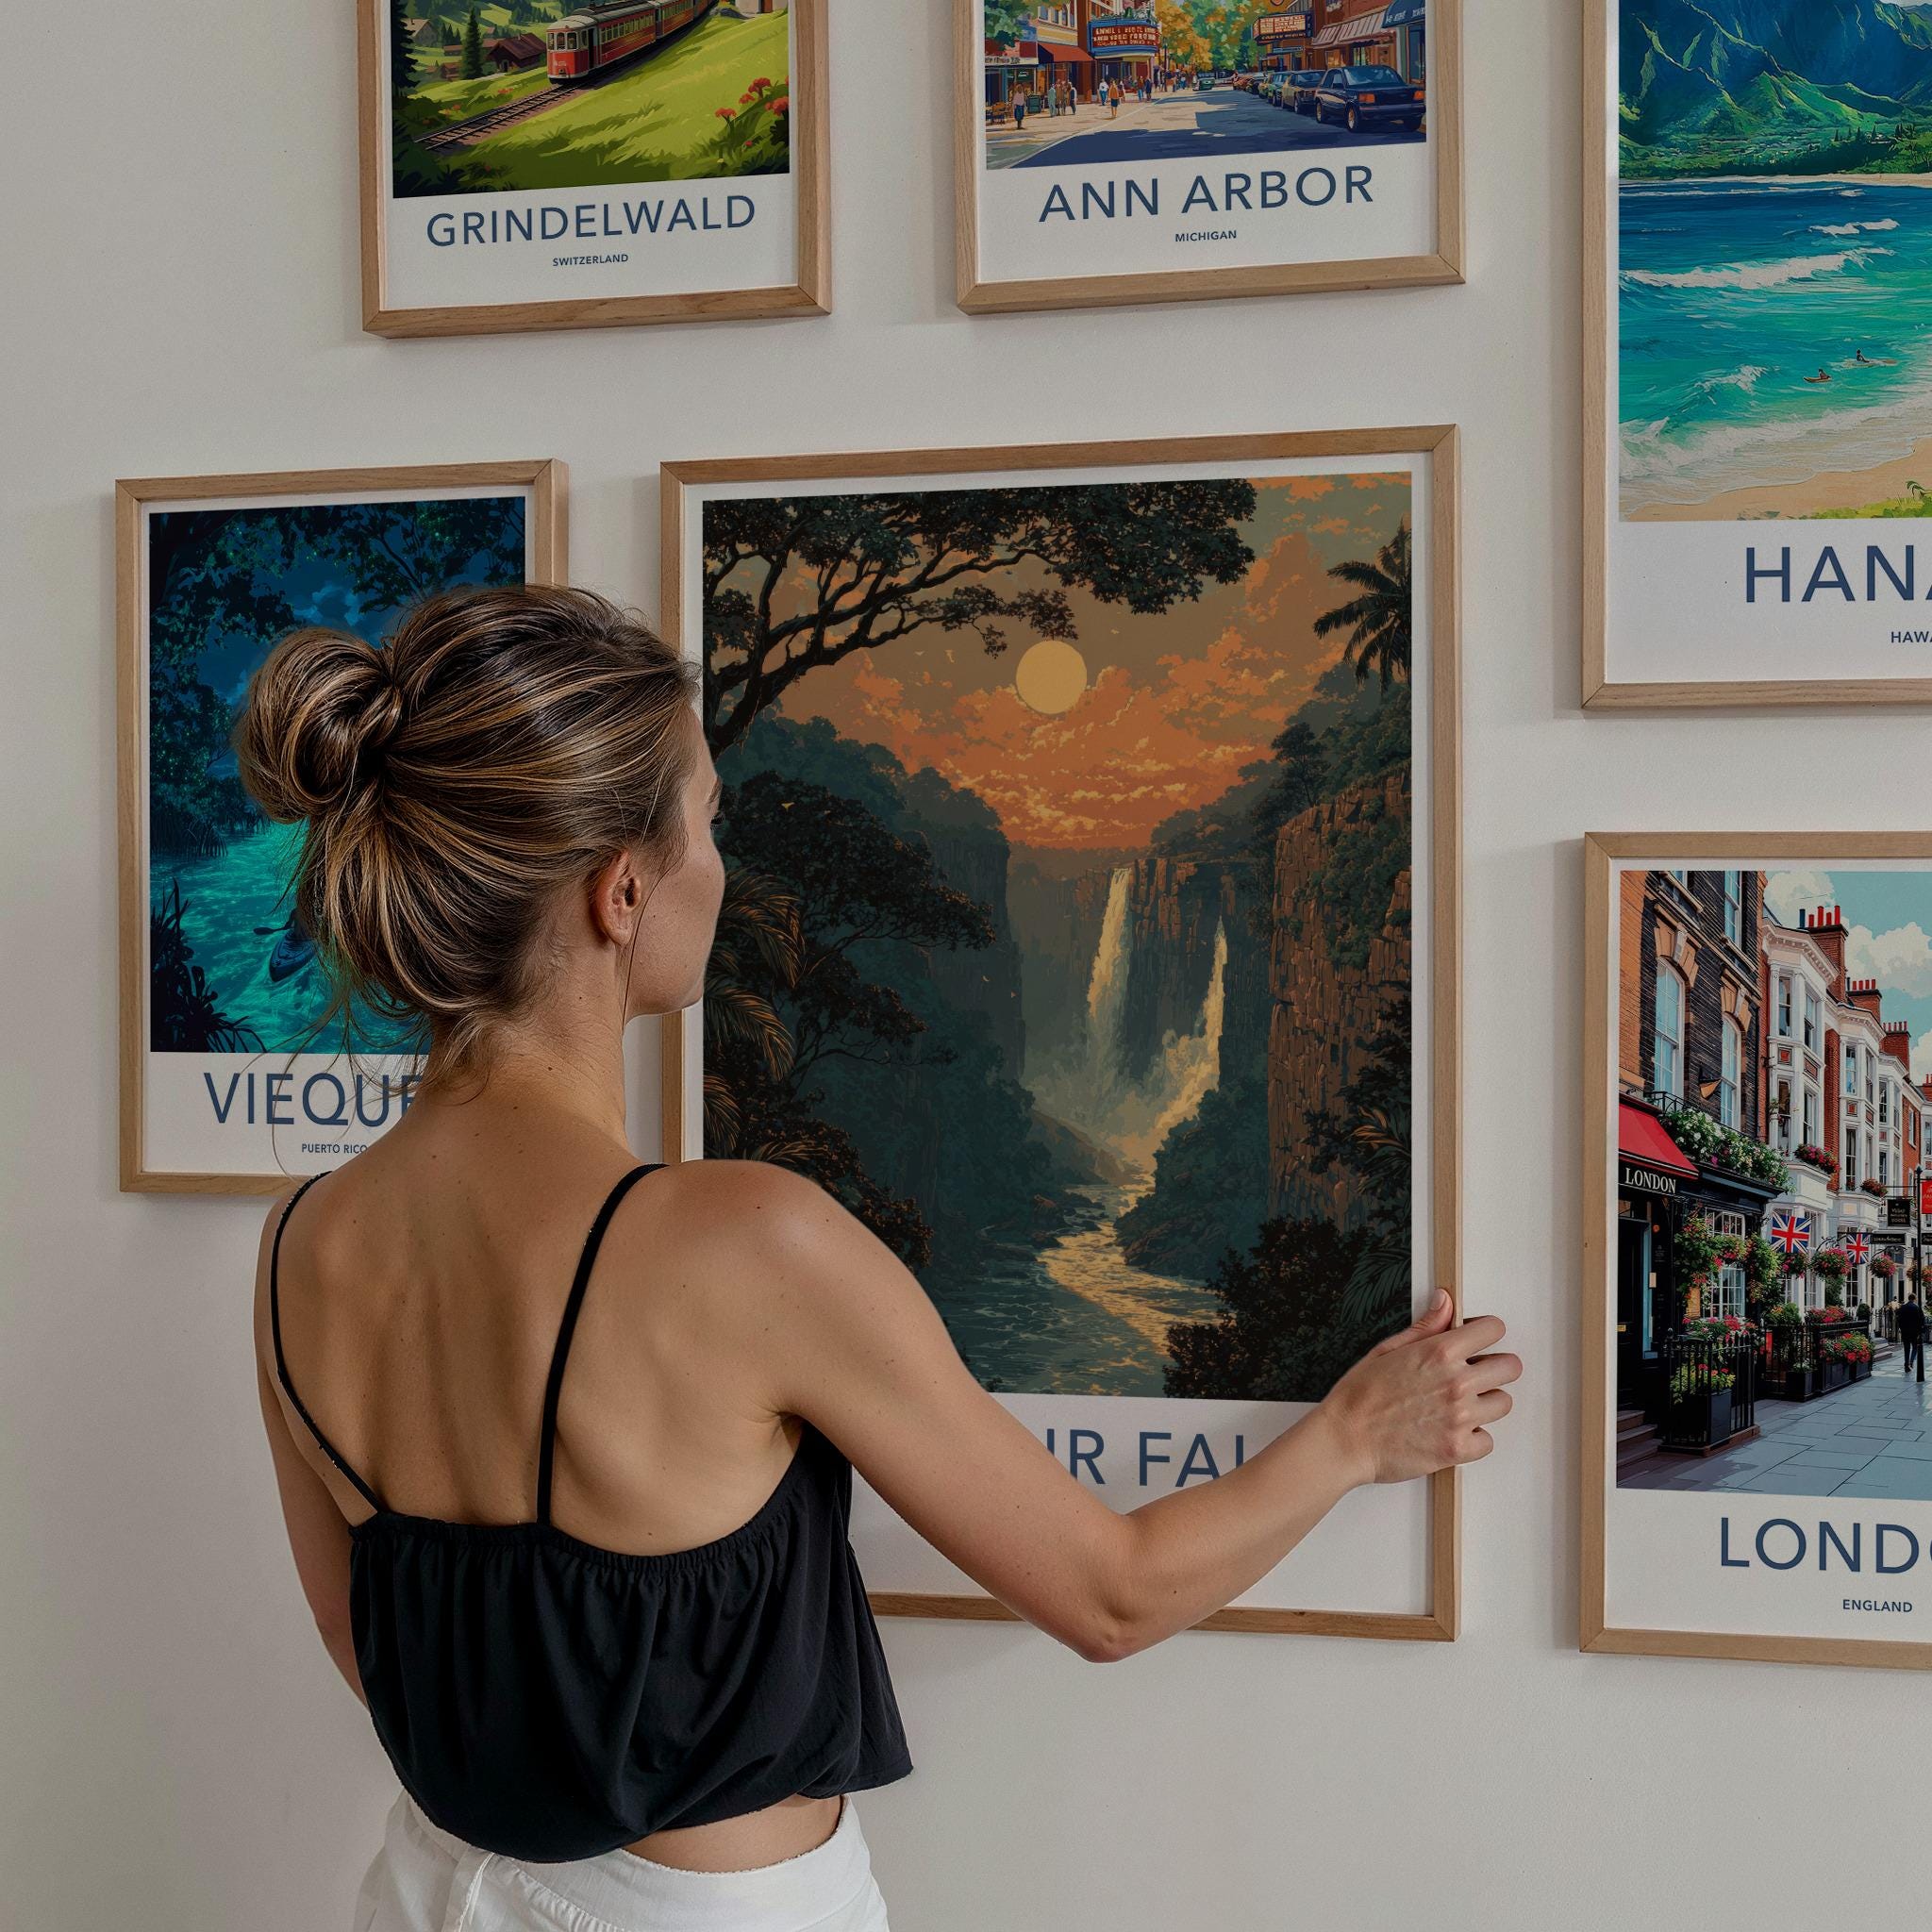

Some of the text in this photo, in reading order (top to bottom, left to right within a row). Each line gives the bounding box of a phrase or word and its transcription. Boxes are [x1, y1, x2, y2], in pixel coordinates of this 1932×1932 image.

[1039, 165, 1374, 223] ANN ARBOR
[426, 194, 756, 247] GRINDELWALD
[1174, 229, 1237, 242] MICHIGAN
[552, 254, 629, 267] SWITZERLAND
[1746, 544, 1932, 604] HAN
[1890, 630, 1932, 643] HAW
[203, 1072, 423, 1127] VIEQUE
[301, 1143, 367, 1154] PUERTO RICO
[1624, 1167, 1676, 1194] LONDON
[1721, 1517, 1932, 1574] LOND
[1842, 1599, 1913, 1613] ENGLAND
